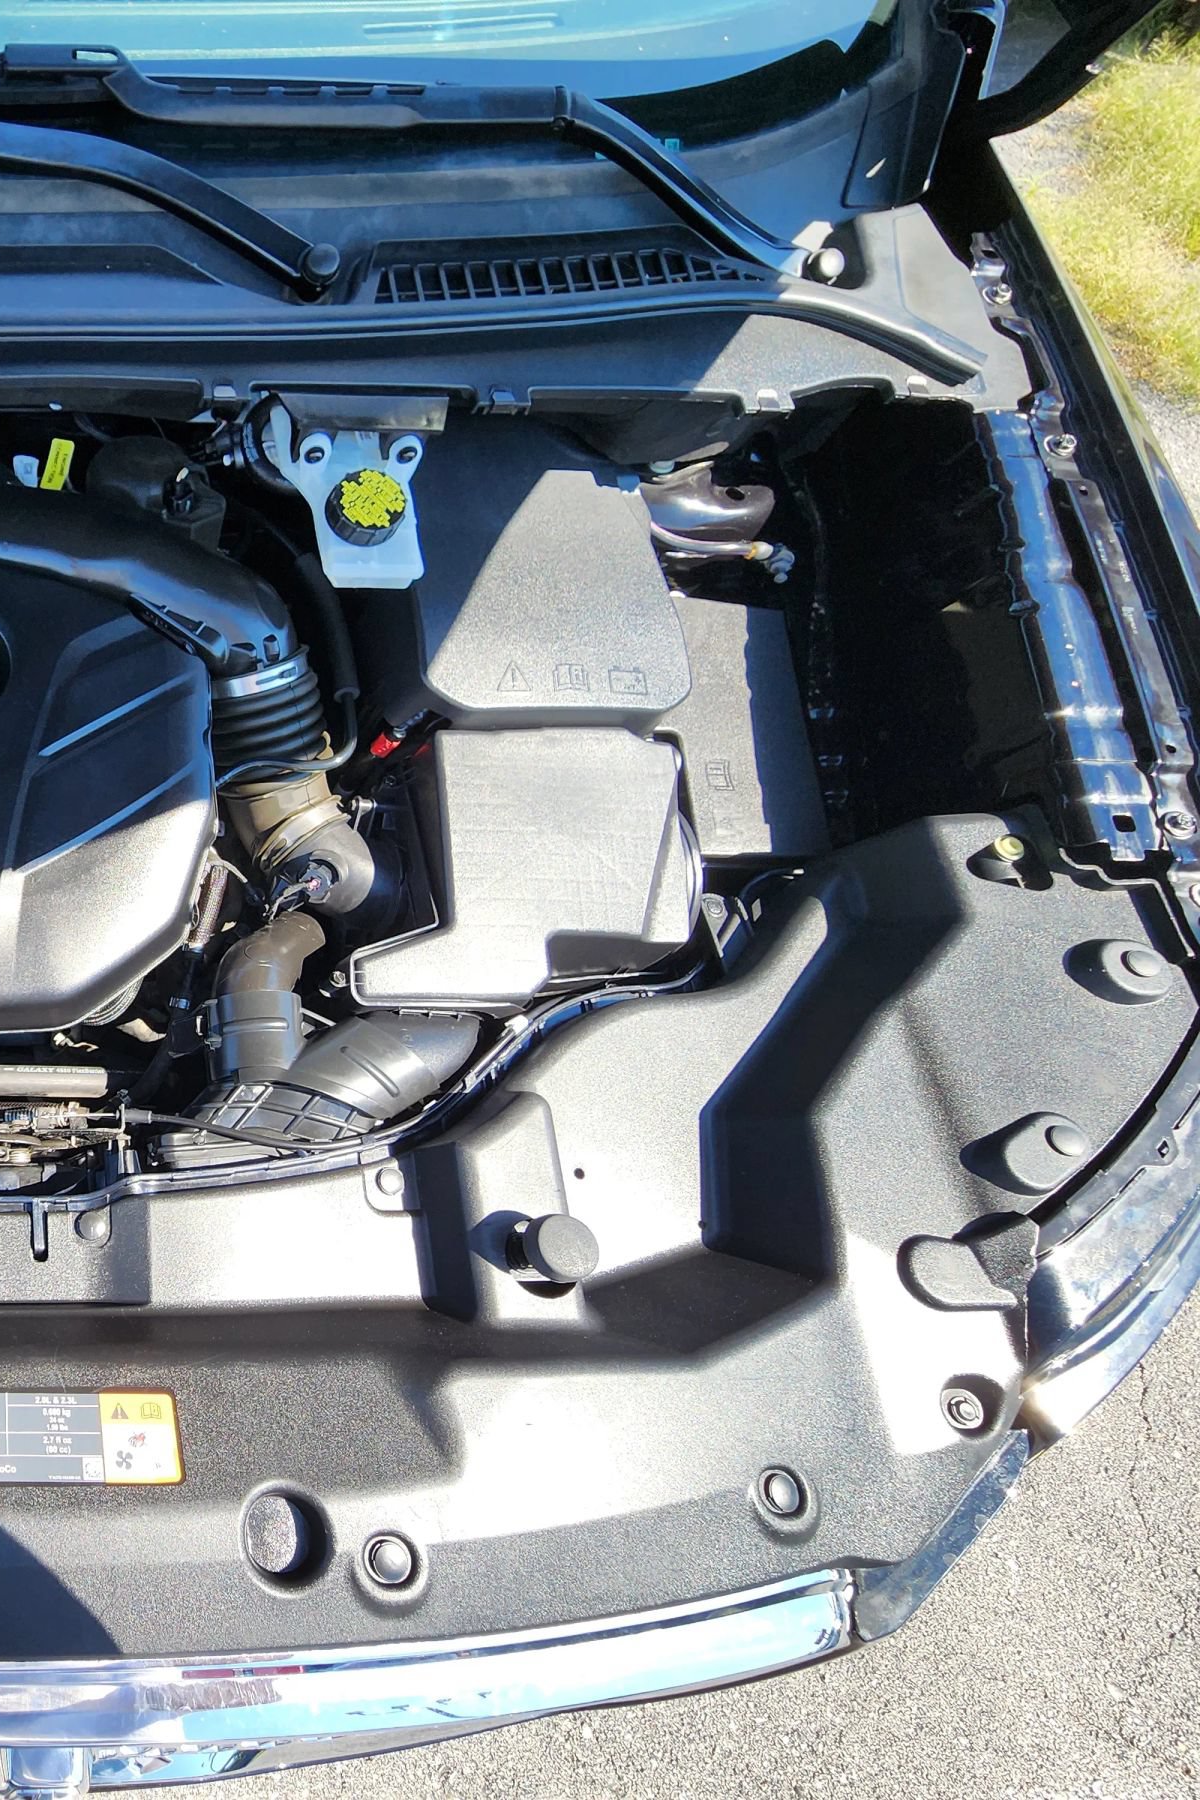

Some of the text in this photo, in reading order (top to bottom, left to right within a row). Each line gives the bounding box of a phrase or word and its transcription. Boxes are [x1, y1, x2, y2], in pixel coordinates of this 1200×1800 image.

[34, 1395, 52, 1404] 2.0L
[61, 1407, 71, 1418] kg
[42, 1436, 55, 1444] 2.7
